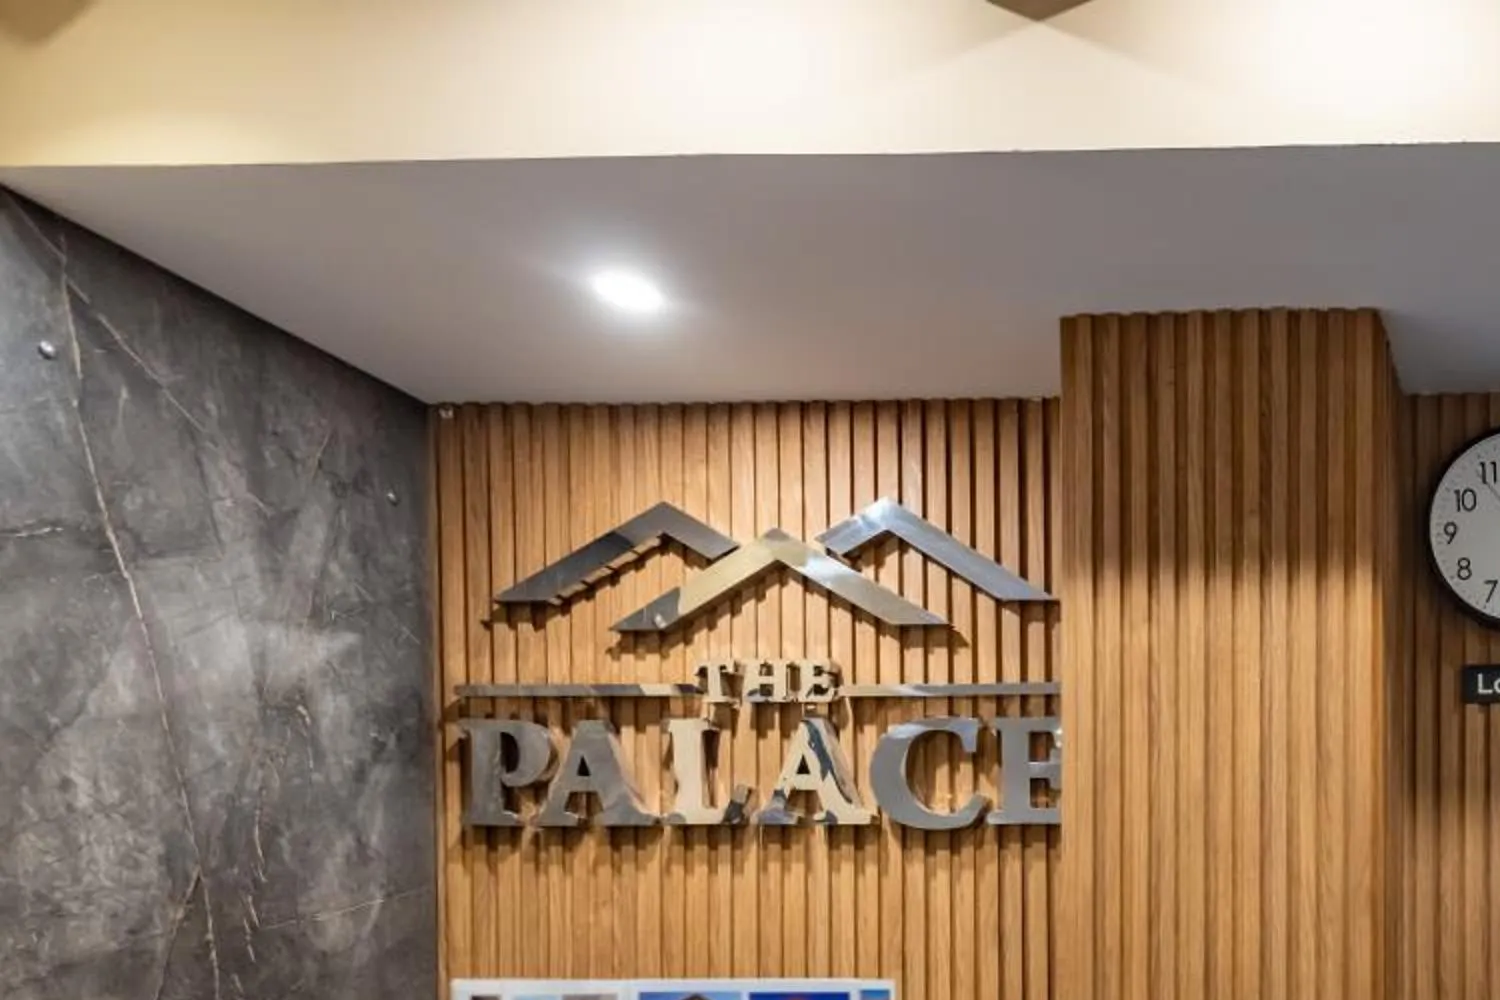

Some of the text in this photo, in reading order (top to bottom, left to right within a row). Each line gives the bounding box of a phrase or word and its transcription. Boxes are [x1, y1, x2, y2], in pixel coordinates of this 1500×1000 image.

[1479, 461, 1497, 485] 11
[1454, 488, 1477, 512] 10
[1443, 522, 1457, 545] 9
[1457, 557, 1472, 580] 8
[1484, 579, 1498, 603] 7
[696, 659, 836, 702] THE
[457, 716, 1061, 829] PALACE
